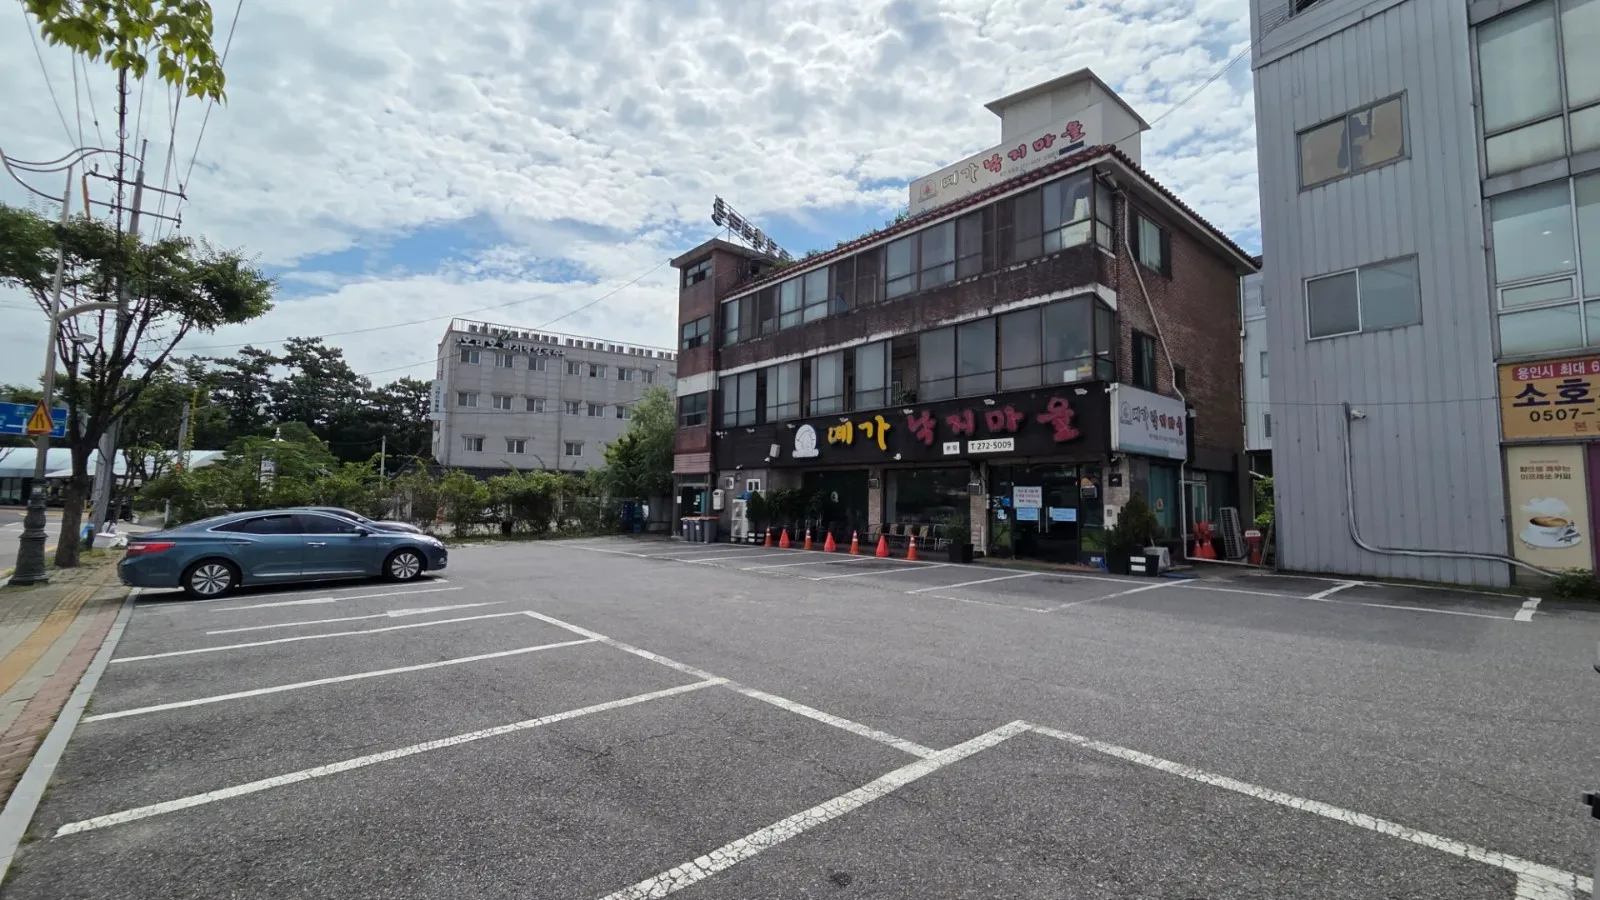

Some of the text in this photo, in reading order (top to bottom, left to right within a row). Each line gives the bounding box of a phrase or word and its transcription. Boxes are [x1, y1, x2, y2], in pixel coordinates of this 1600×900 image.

[1517, 365, 1554, 380] 용인시
[1560, 361, 1585, 375] 최대
[1512, 378, 1600, 408] 소호
[907, 397, 1080, 445] 낙지마을
[1530, 408, 1600, 422] 0507-
